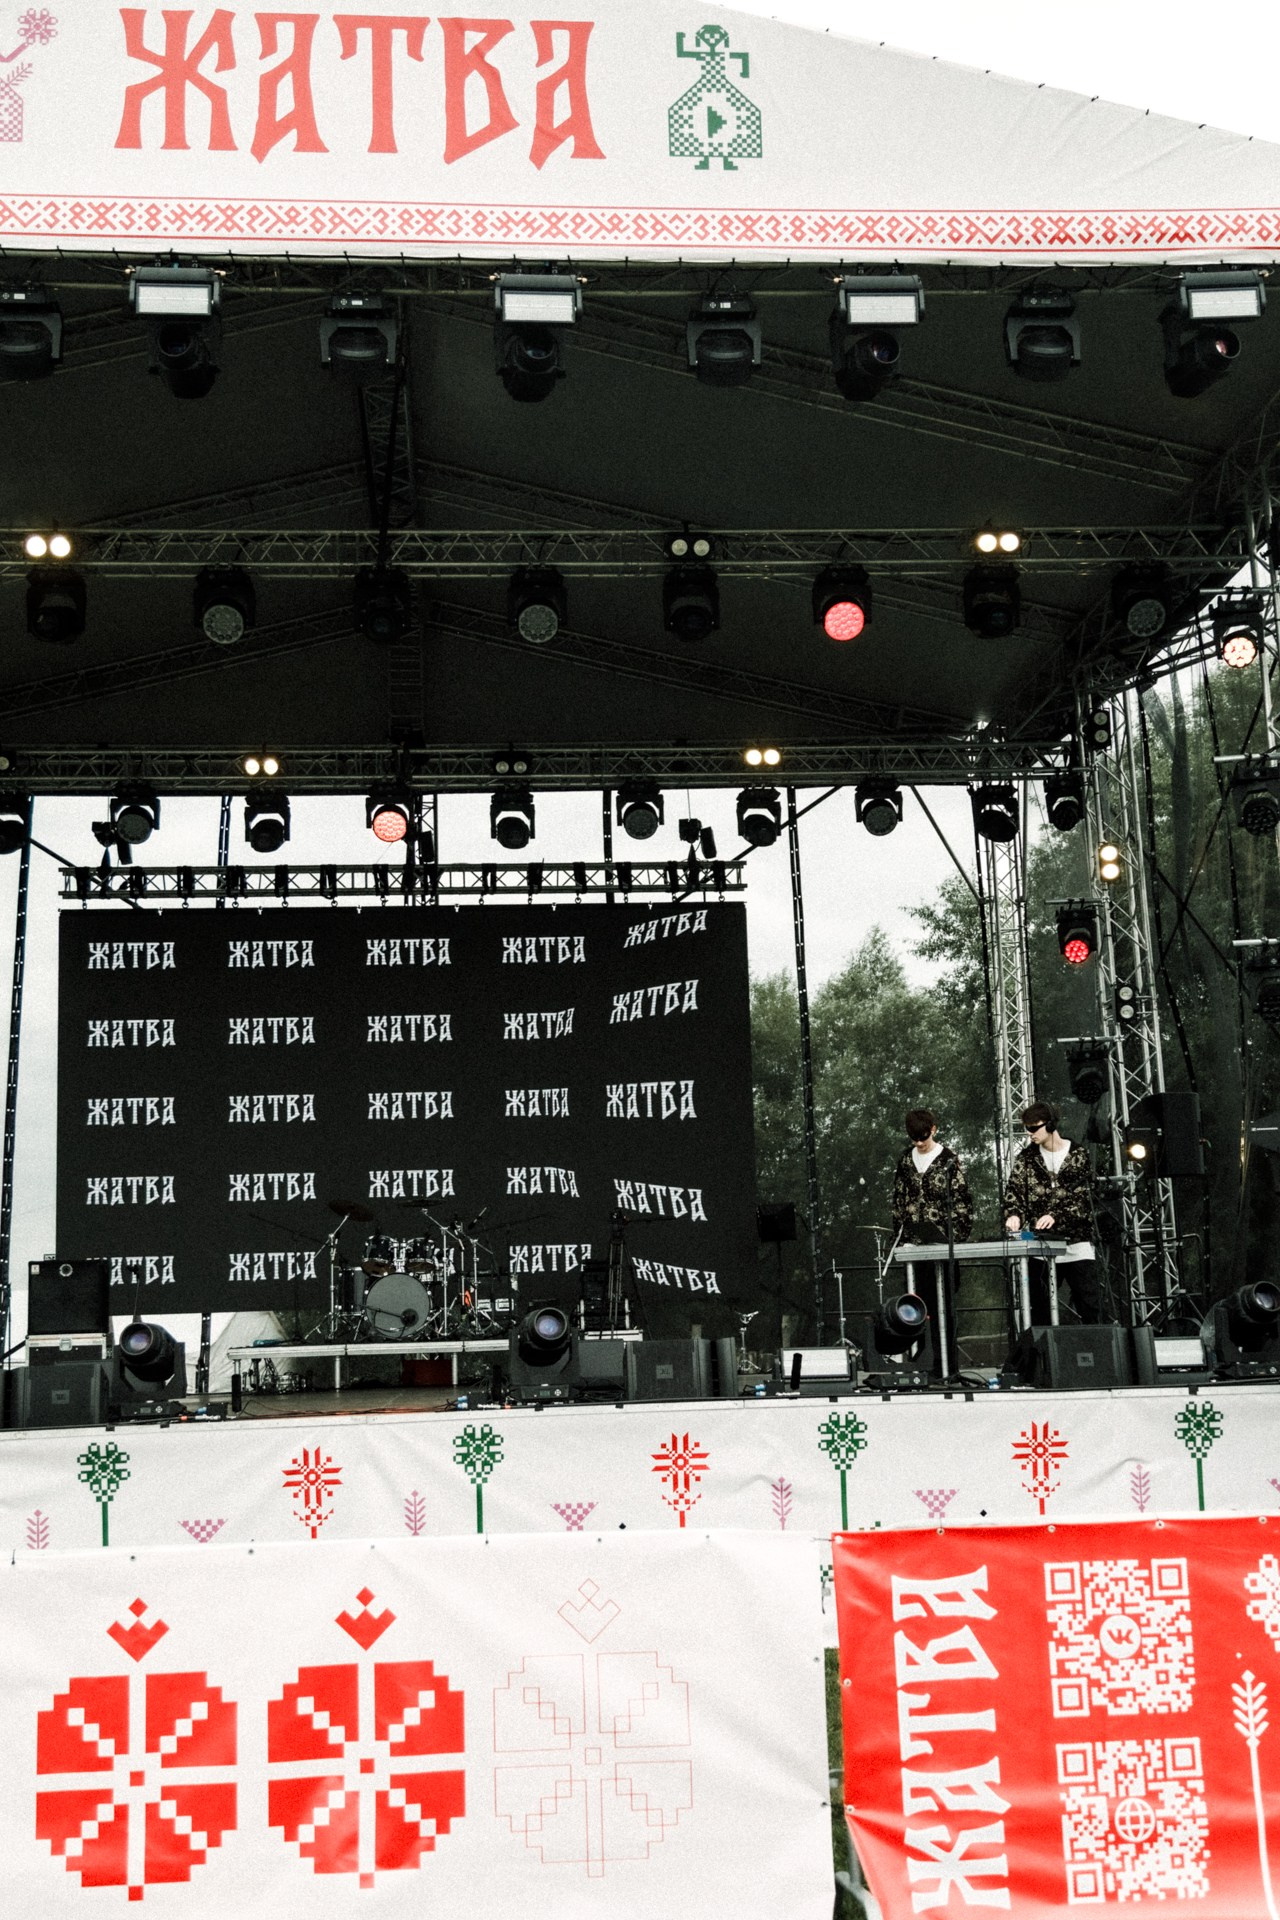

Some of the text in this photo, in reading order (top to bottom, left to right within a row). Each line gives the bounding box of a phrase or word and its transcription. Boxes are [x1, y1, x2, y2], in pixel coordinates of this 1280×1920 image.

[115, 8, 606, 170] ЖАТВА
[623, 910, 708, 948] ЖАТВА
[88, 942, 175, 970] ЖАТВА
[228, 941, 314, 968] ЖАТВА
[366, 938, 452, 966] ЖАТВА
[502, 937, 585, 964] ЖАТВА
[610, 980, 698, 1024] ЖАТВА
[88, 1019, 175, 1048] ЖАТВА
[229, 1017, 315, 1045] ЖАТВА
[367, 1015, 452, 1043] ЖАТВА
[504, 1008, 574, 1040] ЖАТВА
[87, 1097, 175, 1126] ЖАТВА
[229, 1094, 315, 1123] ЖАТВА
[368, 1092, 453, 1120] ЖАТВА
[505, 1088, 569, 1117] ЖАТВА
[606, 1080, 697, 1120] ЖАТВА
[86, 1176, 175, 1205] ЖАТВА
[229, 1173, 316, 1202] ЖАТВА
[369, 1169, 455, 1198] ЖАТВА
[507, 1167, 579, 1197] ЖАТВА
[614, 1179, 707, 1221] ЖАТВА
[87, 1256, 176, 1286] АТВА
[632, 1257, 721, 1294] ЖАТВА
[891, 1565, 1011, 1913] ЖАТВА
